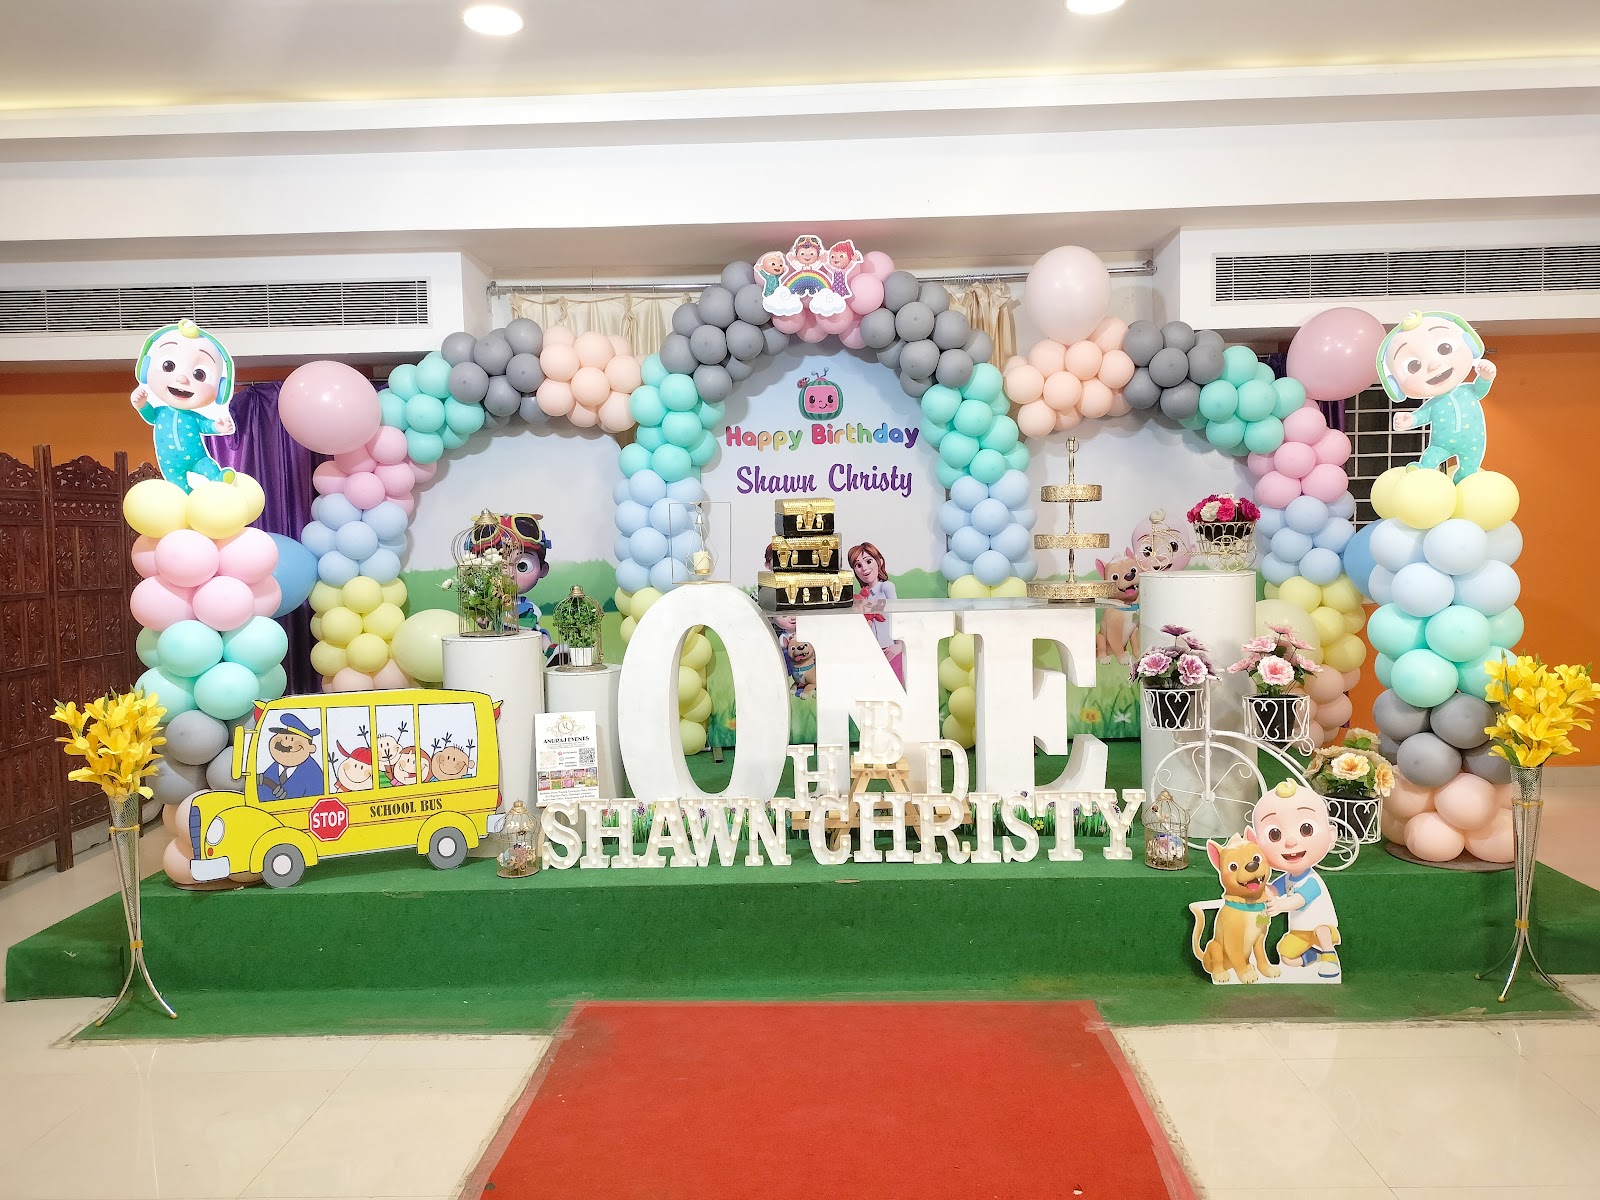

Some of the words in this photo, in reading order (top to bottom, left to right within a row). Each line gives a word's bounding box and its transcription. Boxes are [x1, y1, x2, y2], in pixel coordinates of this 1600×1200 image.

[725, 425, 803, 451] Happy
[811, 422, 920, 449] Birthday
[736, 465, 817, 494] Shawn
[828, 463, 913, 498] Christy
[618, 584, 1109, 801] ONE
[312, 810, 346, 829] STOP
[370, 801, 416, 818] SCHOOL
[420, 798, 443, 812] BUS
[541, 797, 792, 870] SHAWN
[809, 789, 1147, 865] CHRISTY
